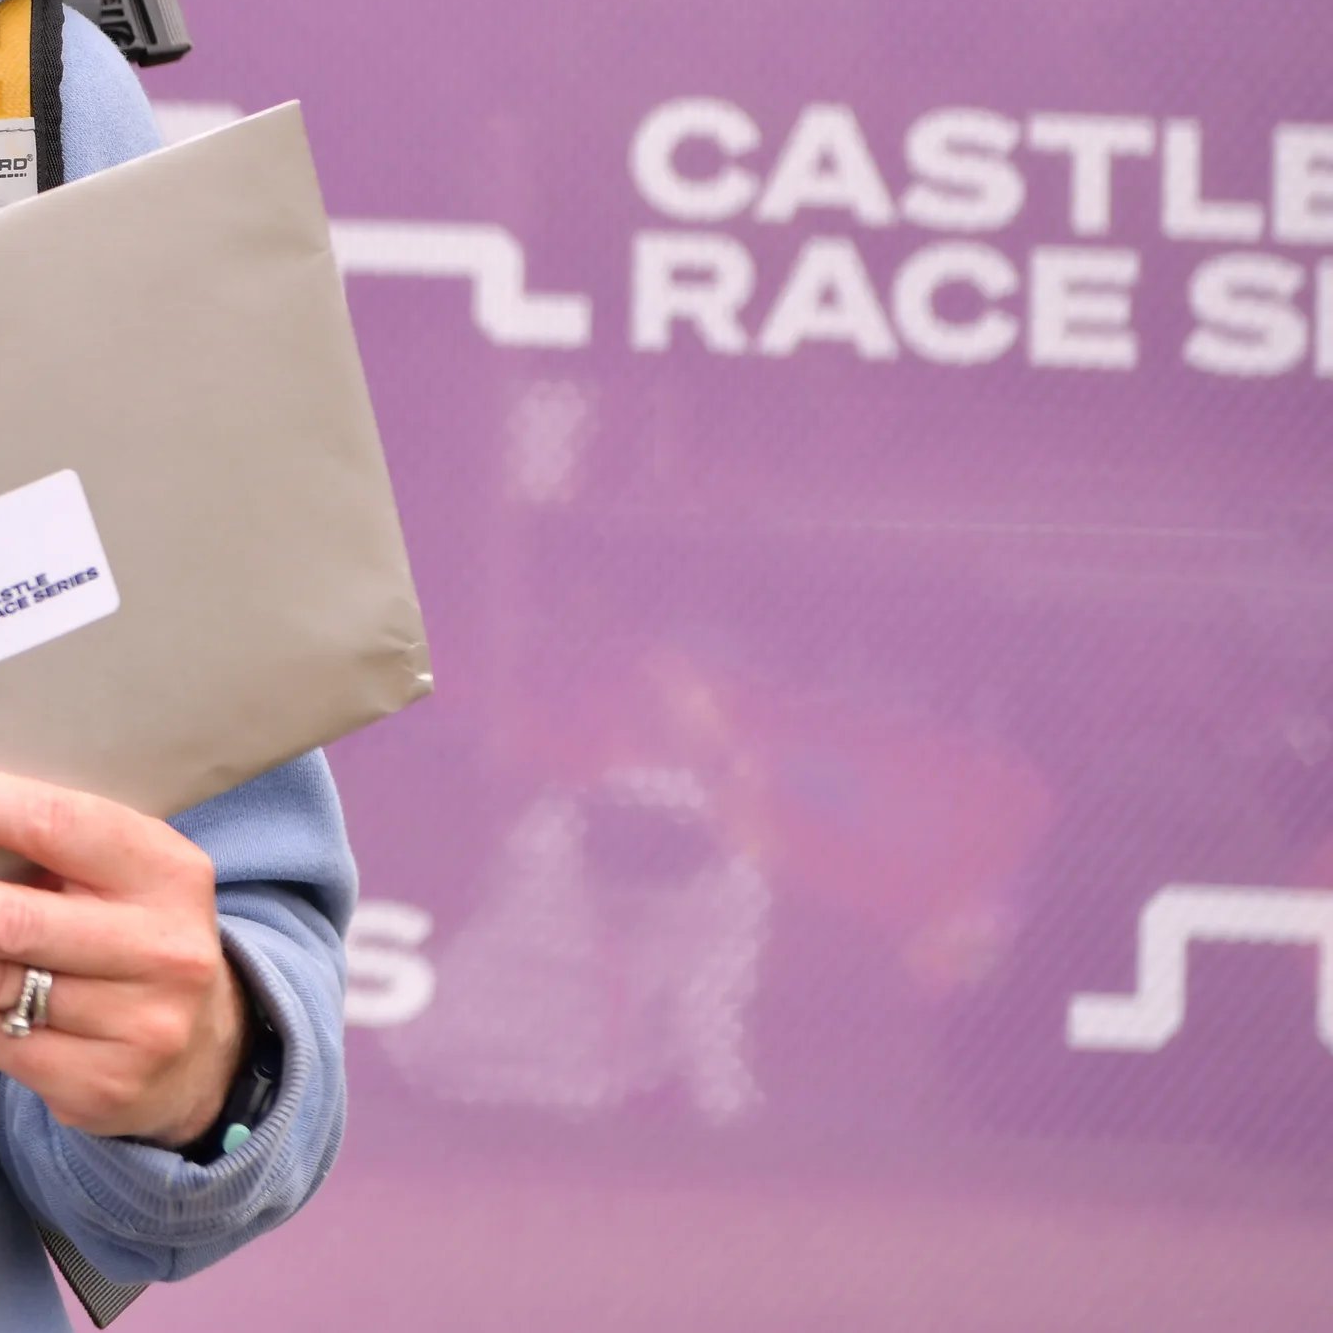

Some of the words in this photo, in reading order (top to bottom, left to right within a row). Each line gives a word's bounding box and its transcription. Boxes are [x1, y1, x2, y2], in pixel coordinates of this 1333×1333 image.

[629, 96, 1333, 247] CASTLE
[629, 229, 1141, 370] RACE
[1184, 251, 1333, 380] S
[33, 566, 99, 603] SERIES
